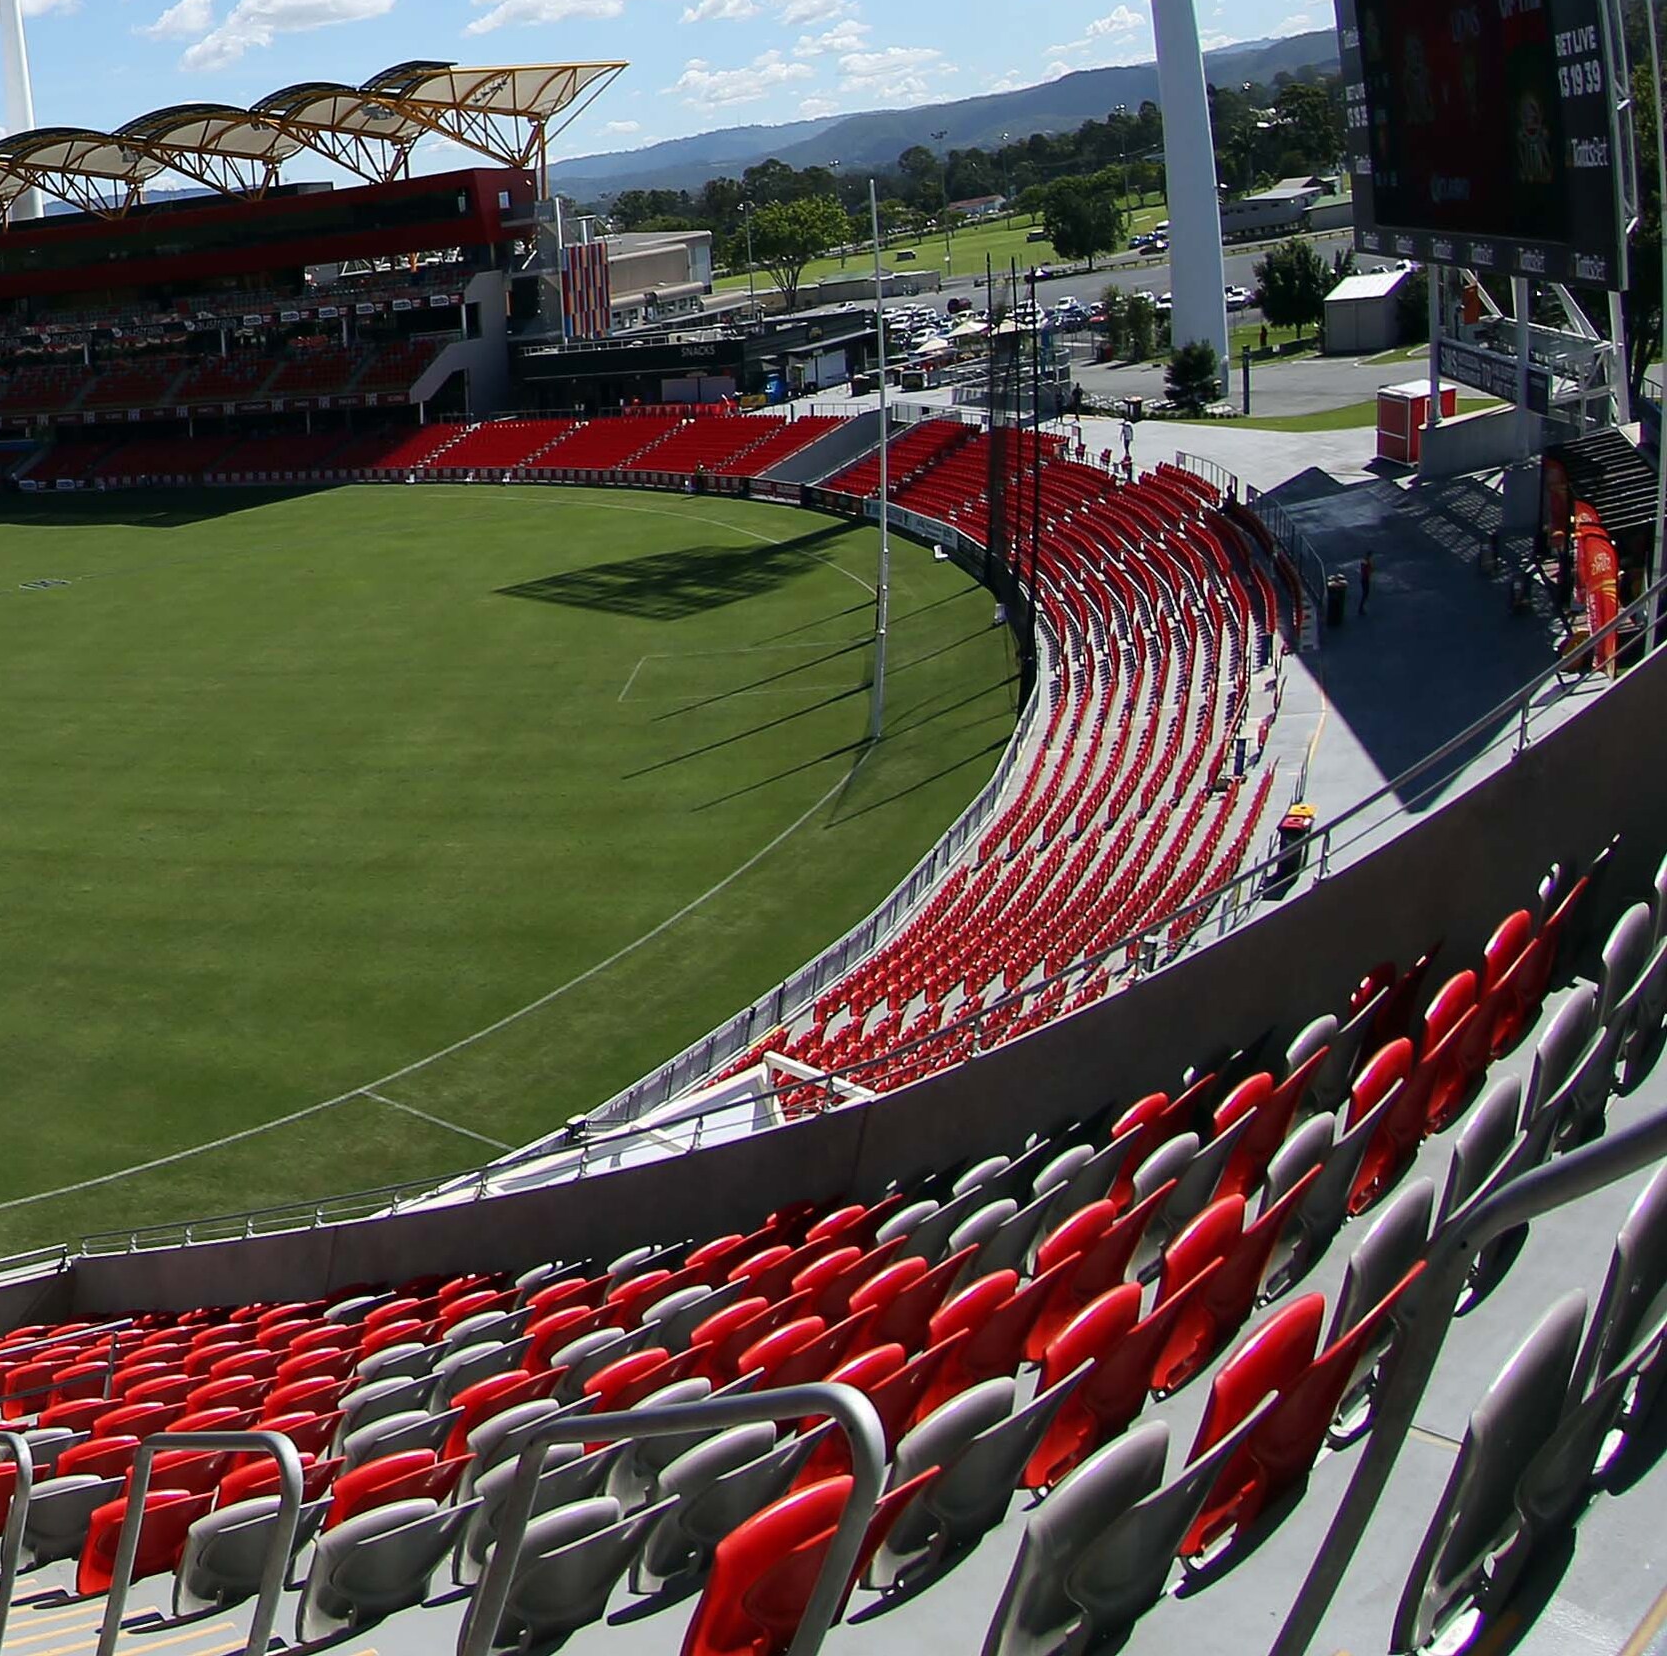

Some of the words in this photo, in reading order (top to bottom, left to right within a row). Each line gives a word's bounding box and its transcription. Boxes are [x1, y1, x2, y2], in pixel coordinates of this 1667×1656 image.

[1555, 32, 1575, 58] BET
[1575, 25, 1597, 52] LIVE
[1559, 68, 1570, 98] 13
[1572, 63, 1584, 96] 19
[1585, 59, 1601, 93] 39
[1570, 136, 1609, 168] TattsBet
[681, 345, 715, 357] SNACKS
